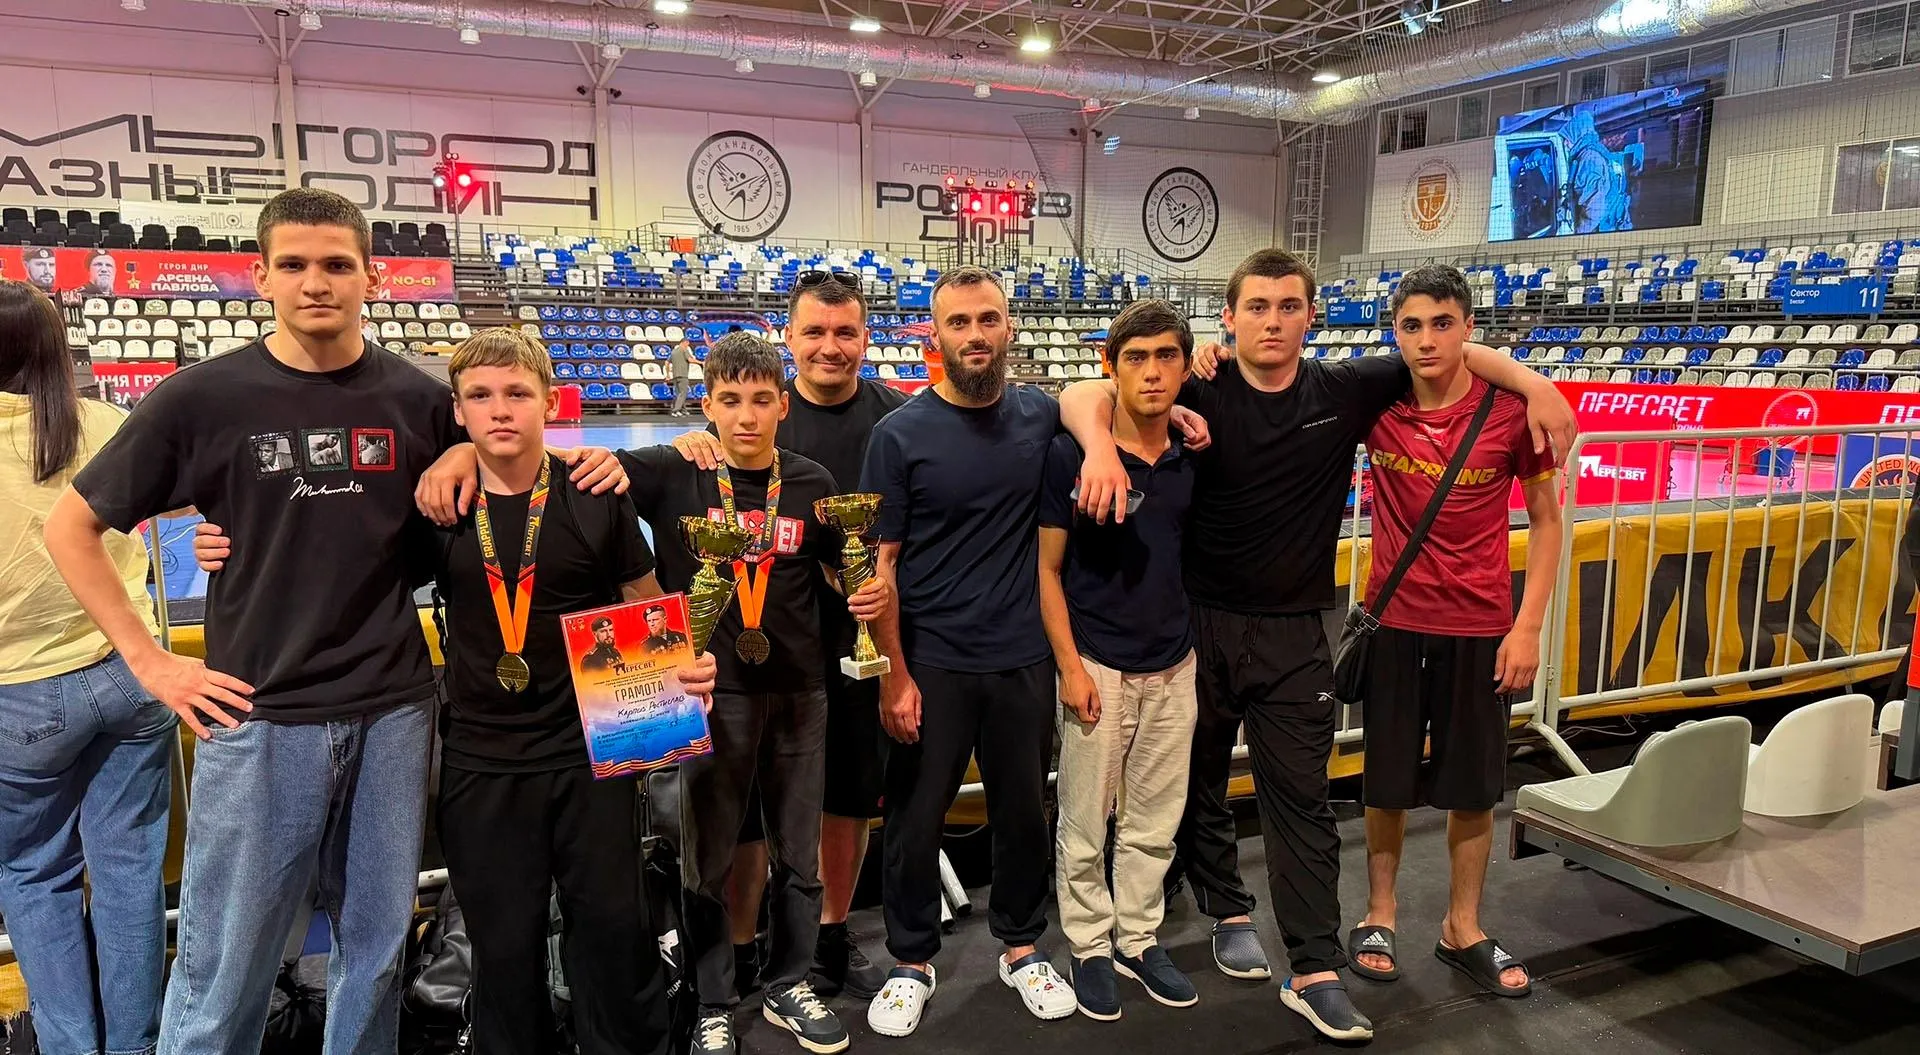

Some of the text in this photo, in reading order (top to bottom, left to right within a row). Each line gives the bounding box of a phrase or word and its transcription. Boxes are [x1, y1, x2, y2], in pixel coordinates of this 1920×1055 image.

[296, 123, 596, 177] ГОРОД
[0, 156, 287, 204] АЗНЫЕ
[902, 161, 1047, 180] ГАНДБОЛЬНЫЙ КЛУБ
[733, 224, 750, 233] 1965
[919, 214, 1034, 246] ДОН
[158, 262, 187, 271] ГЕРОЯ
[151, 282, 220, 293] ПАВЛОВА
[156, 273, 212, 283] АРСЕНА
[393, 276, 437, 286] NO-GI
[1790, 287, 1879, 308] Сектор 11
[1360, 304, 1374, 319] 10
[1371, 448, 1497, 485] GRAPPING
[1860, 459, 1902, 484] UNTED
[476, 509, 495, 558] GRAPPLING
[614, 680, 665, 702] ГРАМОТА
